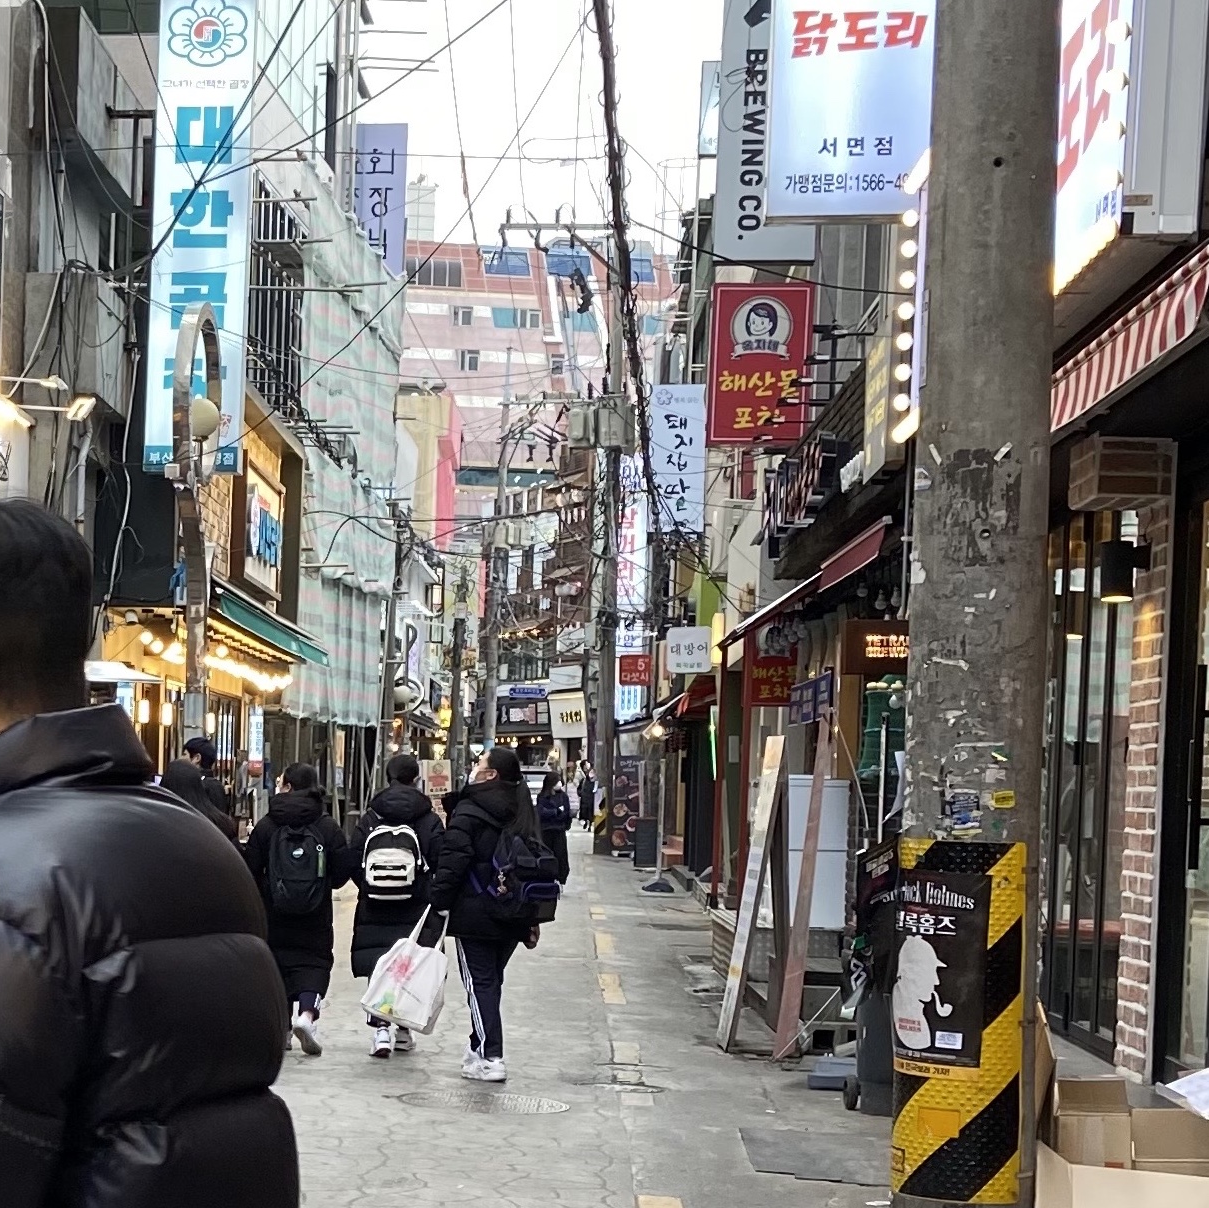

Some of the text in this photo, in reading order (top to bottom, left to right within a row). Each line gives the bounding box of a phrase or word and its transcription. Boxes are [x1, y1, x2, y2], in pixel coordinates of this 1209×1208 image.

[791, 10, 928, 59] 닭도리
[737, 49, 769, 240] BREWING CO.
[719, 369, 800, 398] 해산물
[670, 642, 708, 656] 대방어
